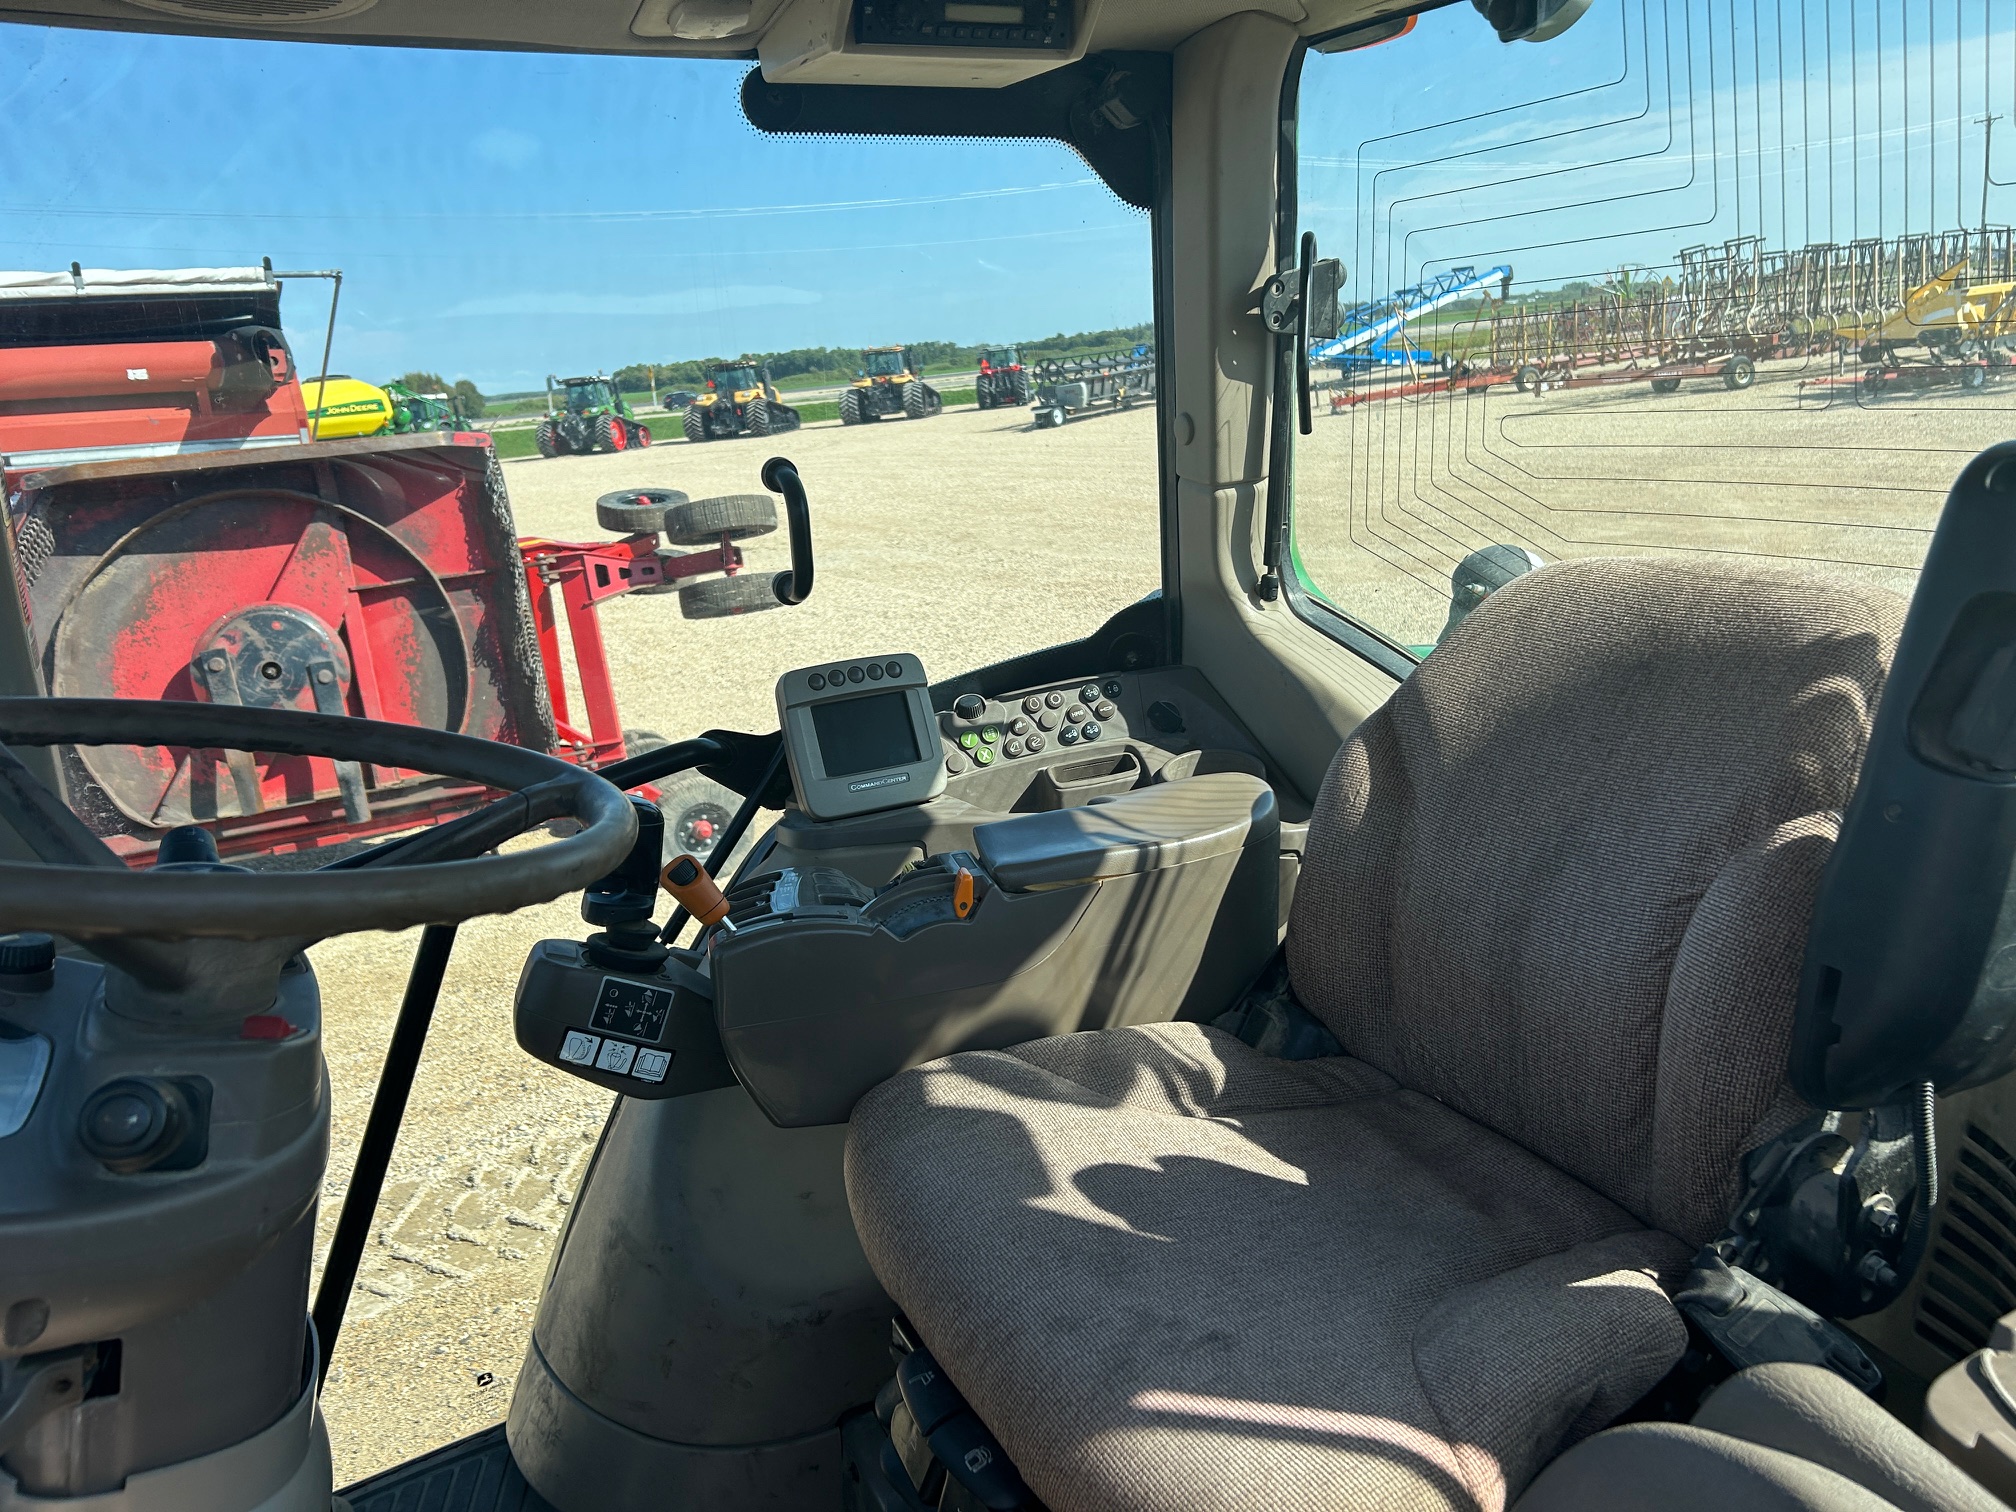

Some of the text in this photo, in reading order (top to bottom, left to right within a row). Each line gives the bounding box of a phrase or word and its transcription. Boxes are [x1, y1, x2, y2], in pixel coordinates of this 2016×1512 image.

[326, 403, 379, 415] JOHN DEERE
[1071, 709, 1084, 718] HMS
